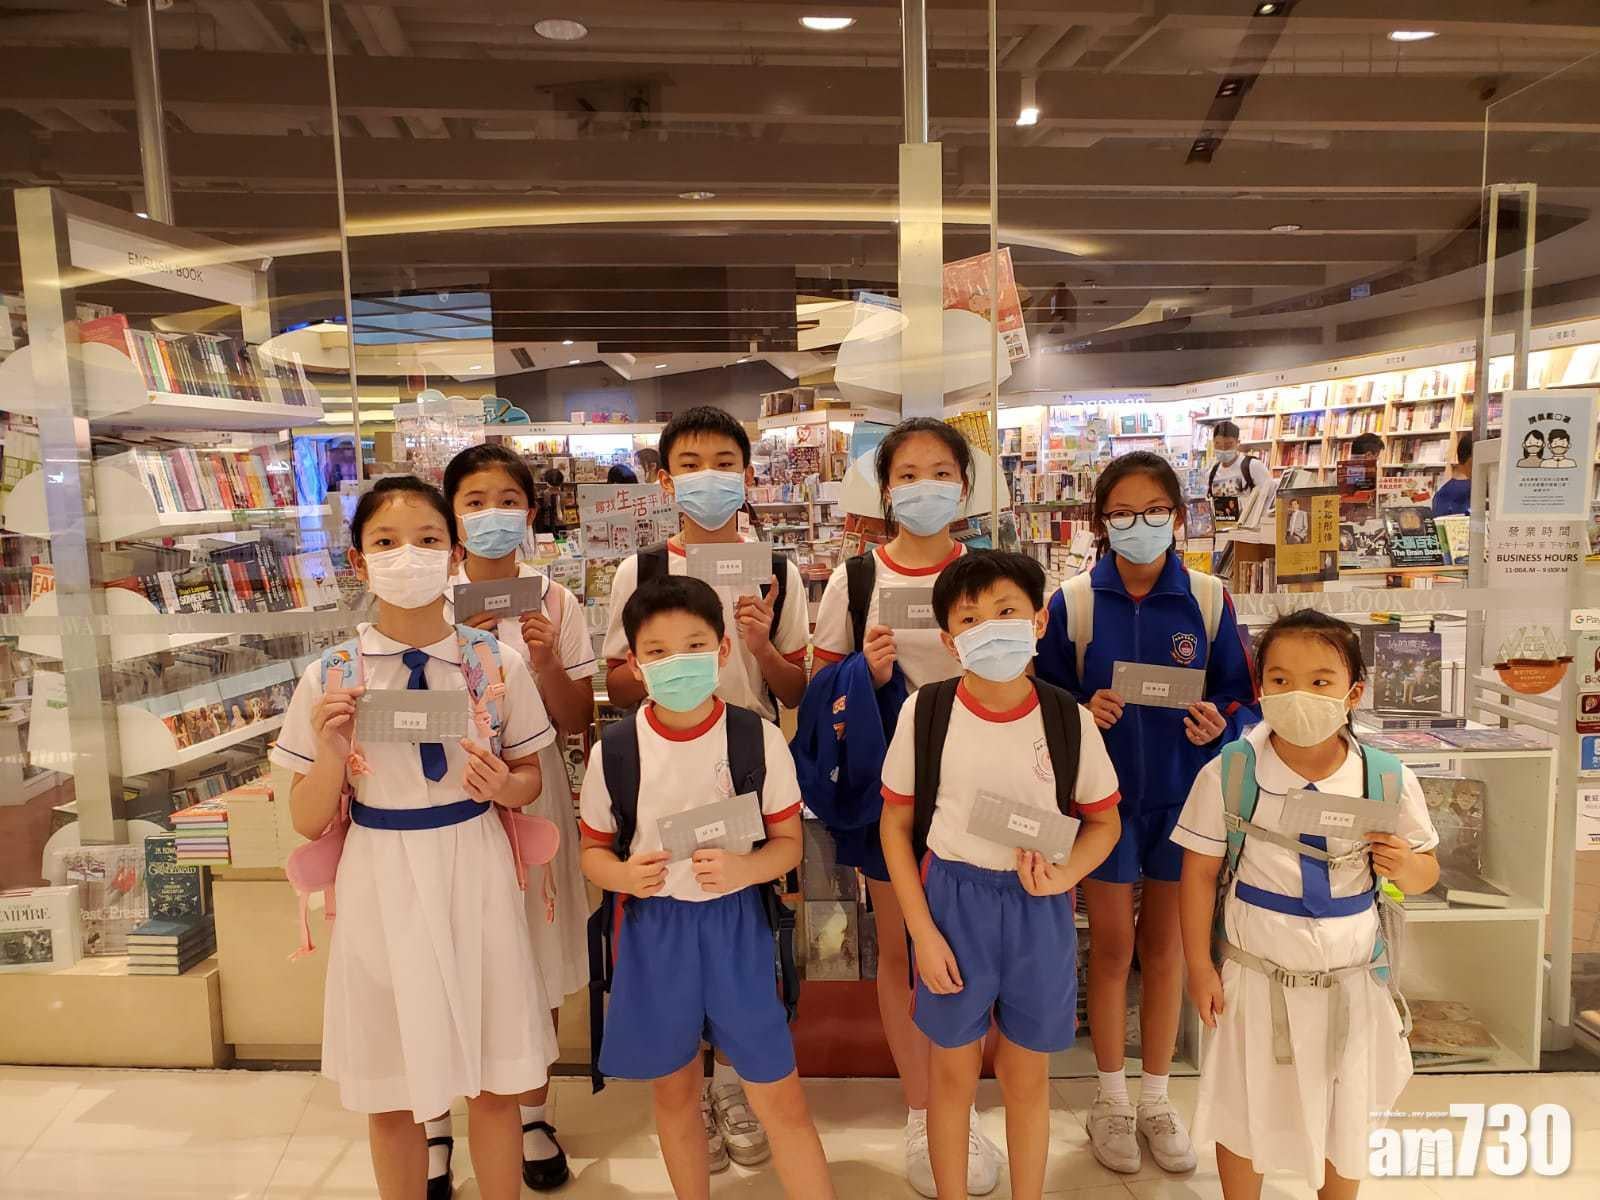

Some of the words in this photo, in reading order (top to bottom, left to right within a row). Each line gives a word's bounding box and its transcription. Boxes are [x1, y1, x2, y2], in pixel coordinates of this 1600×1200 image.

[175, 266, 204, 283] BOOK
[1508, 526, 1571, 537] 營業時間
[1391, 535, 1440, 549] 大腦百科
[1405, 548, 1424, 556] Brain
[1496, 553, 1542, 562] BUSINESS
[1544, 553, 1578, 562] HOURS
[1343, 591, 1406, 611] BOOK
[1413, 590, 1451, 610] CO.
